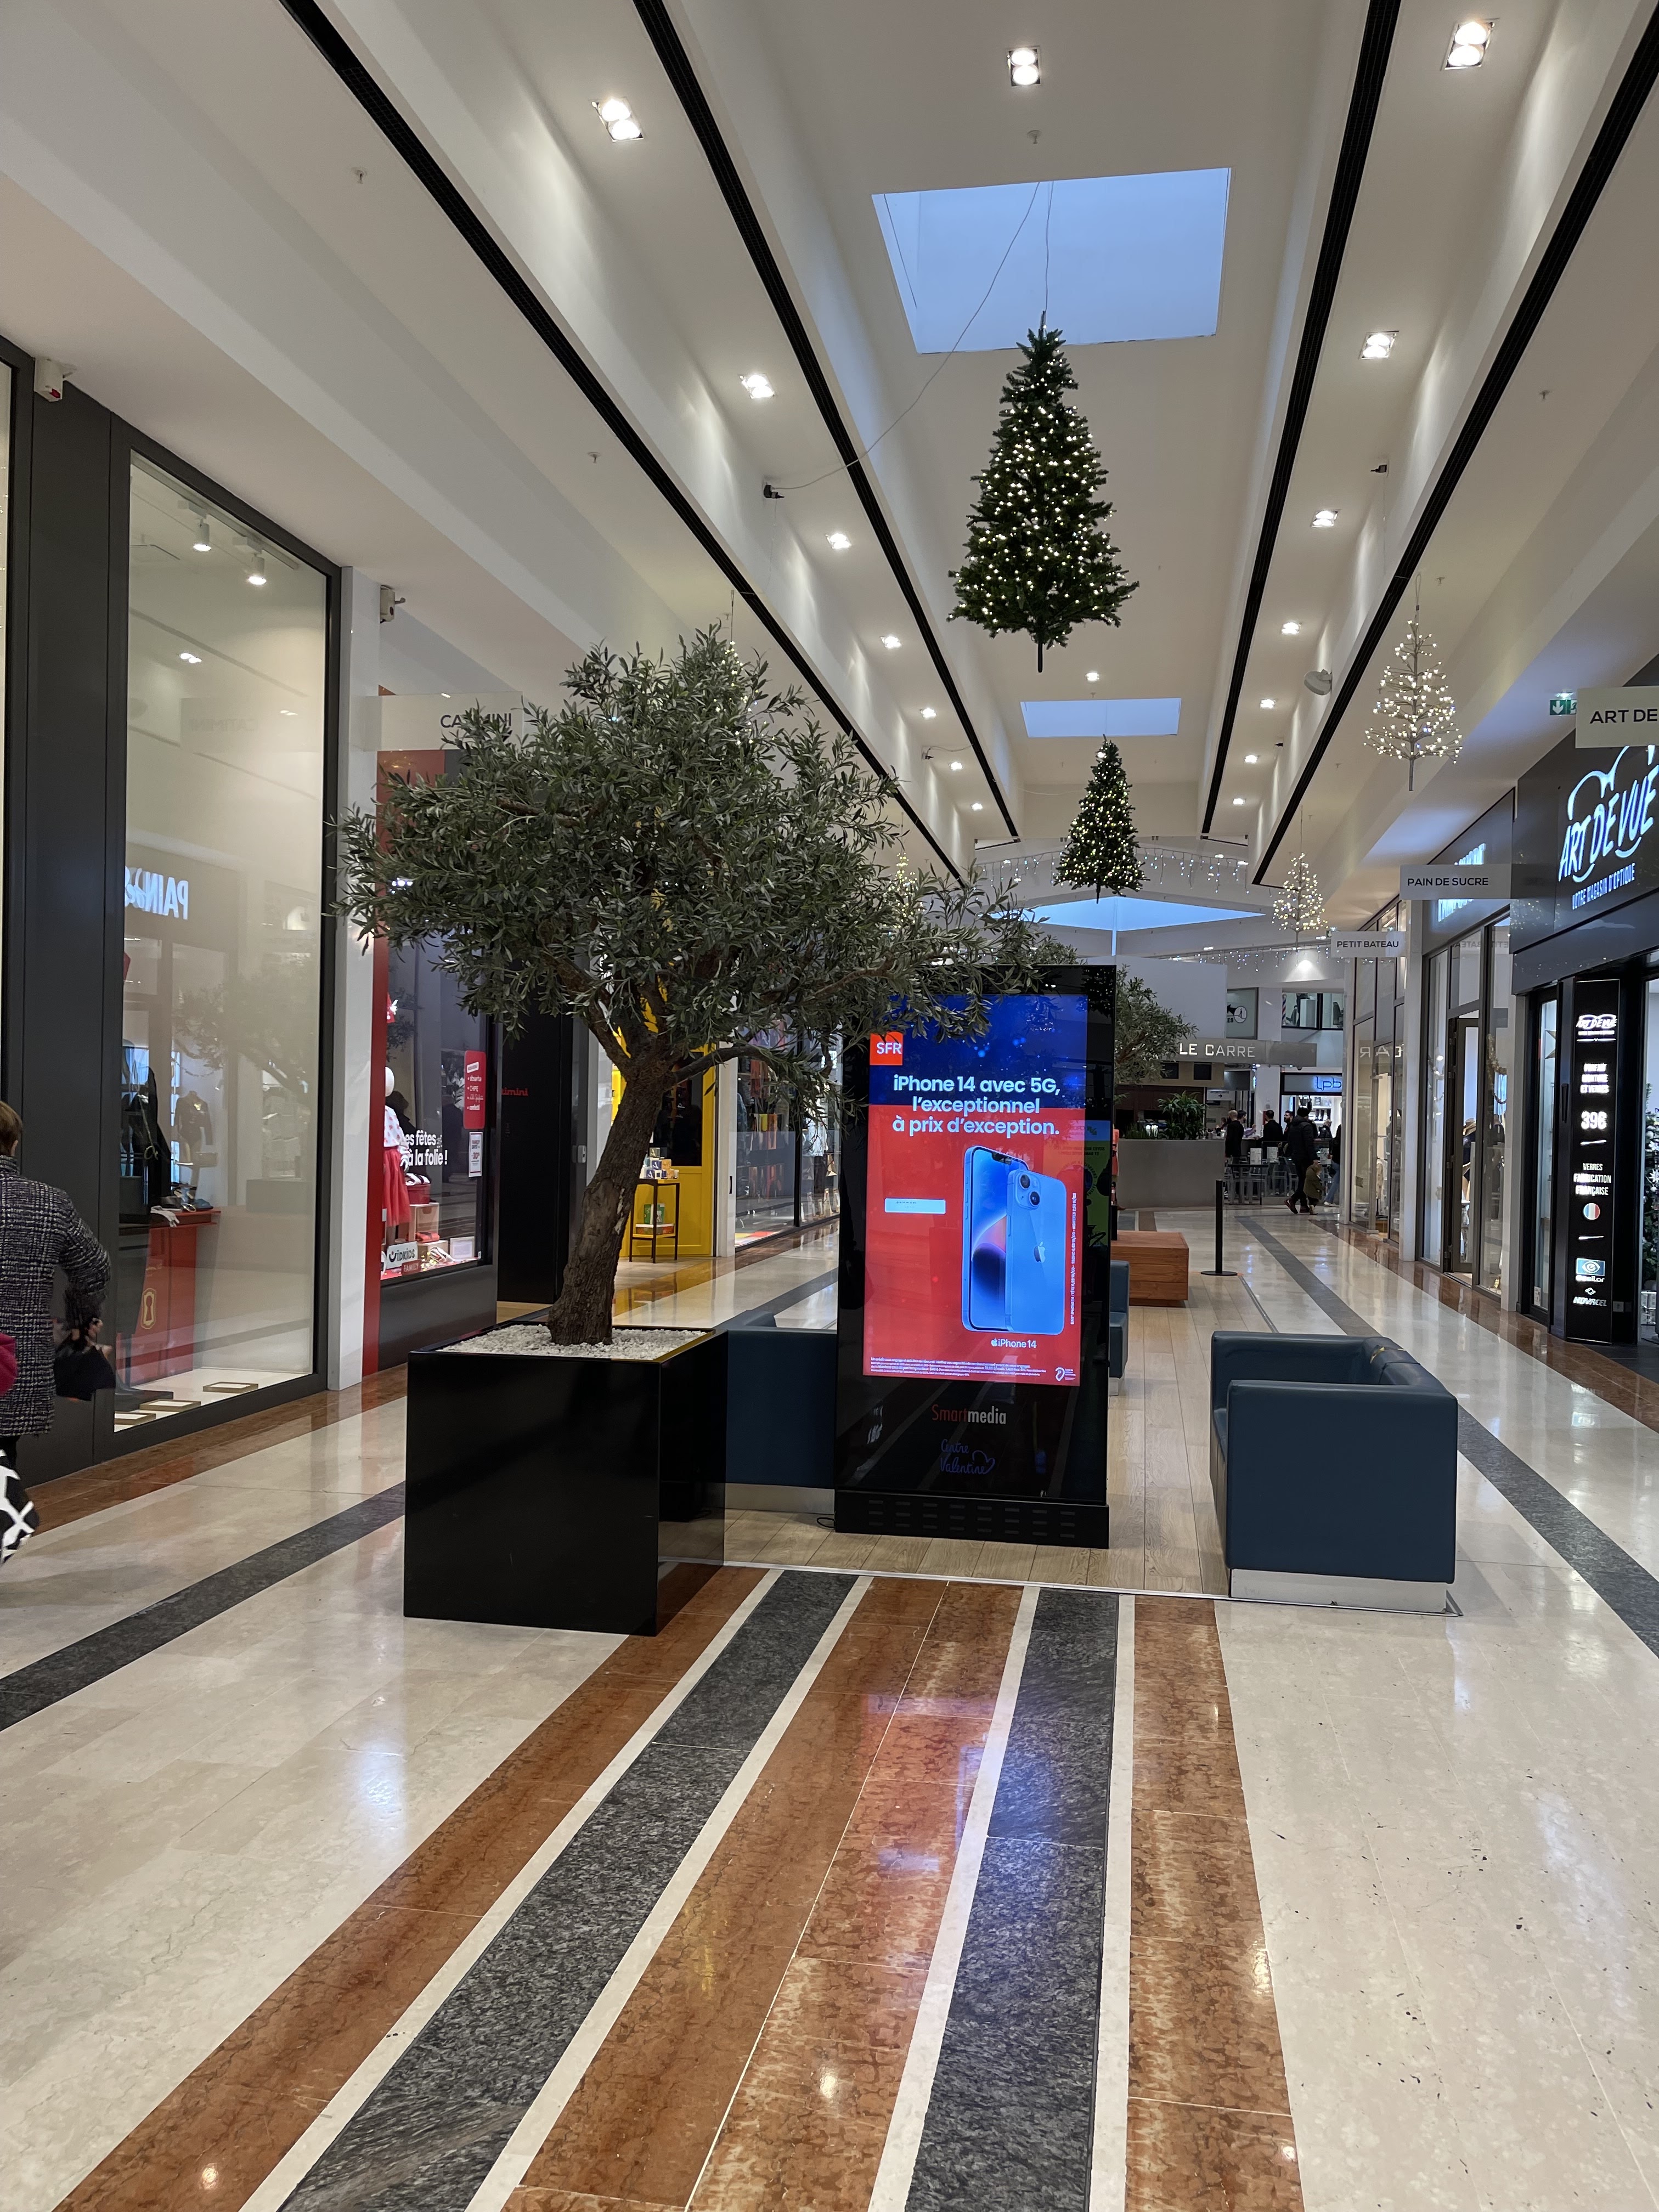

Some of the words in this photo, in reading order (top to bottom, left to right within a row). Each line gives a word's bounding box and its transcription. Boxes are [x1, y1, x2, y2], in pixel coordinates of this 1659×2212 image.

[441, 713, 511, 728] CAMINI
[1590, 709, 1629, 724] ART
[1633, 708, 1658, 723] DE
[1559, 815, 1591, 881] ART
[1590, 792, 1620, 864] DE
[1617, 764, 1659, 847] VUE
[1407, 878, 1432, 886] PAIN
[1452, 877, 1488, 885] SUCRE
[876, 1042, 902, 1054] SFR
[1180, 1043, 1198, 1056] LE
[1205, 1043, 1255, 1058] CARRÉ
[894, 1074, 955, 1092] iPhone
[957, 1076, 975, 1092] 14
[980, 1079, 1026, 1093] avec
[1030, 1077, 1060, 1096] 5G,
[912, 1096, 1040, 1117] l'exceptionnel
[893, 1115, 905, 1132] à
[910, 1116, 944, 1137] prix
[405, 1133, 415, 1146] es
[416, 1130, 437, 1146] fêtes
[408, 1148, 414, 1166] à
[415, 1149, 424, 1166] la
[1583, 1163, 1603, 1171] VERRES
[1576, 1185, 1609, 1197] FRANÇAISE
[404, 1262, 419, 1273] FAMILY
[1573, 1296, 1607, 1307] NOVACEL
[998, 1339, 1027, 1348] iPhone
[1028, 1340, 1037, 1348] 14
[932, 1404, 1007, 1425] Smartmedia
[941, 1438, 970, 1454] Centre
[940, 1457, 990, 1475] Valentine
